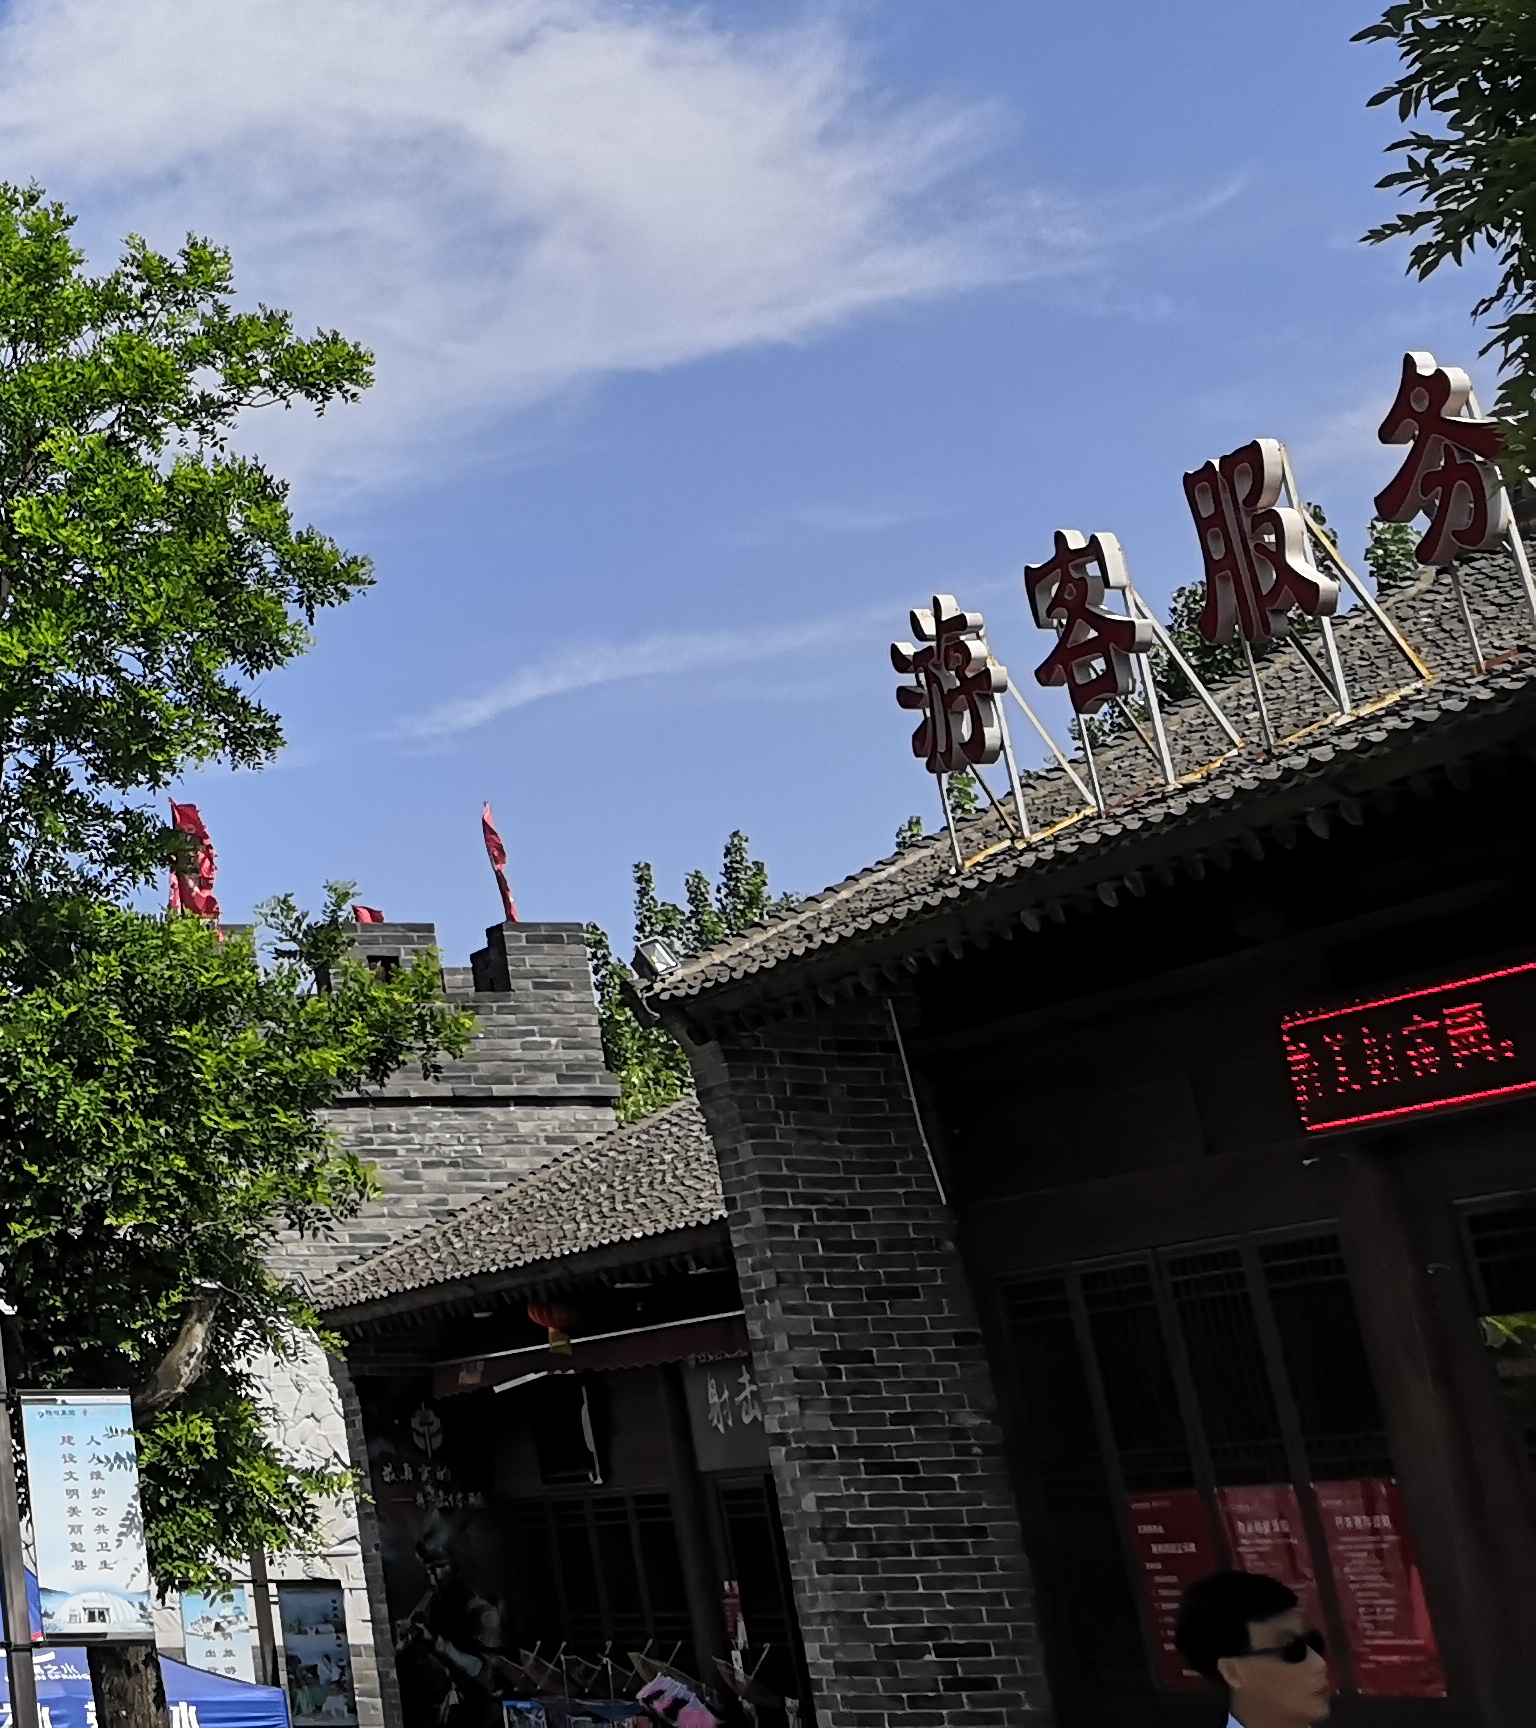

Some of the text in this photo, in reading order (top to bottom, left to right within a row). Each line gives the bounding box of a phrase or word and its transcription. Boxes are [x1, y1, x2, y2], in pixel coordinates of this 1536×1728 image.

[86, 1435, 114, 1570] 人人维护公共卫生
